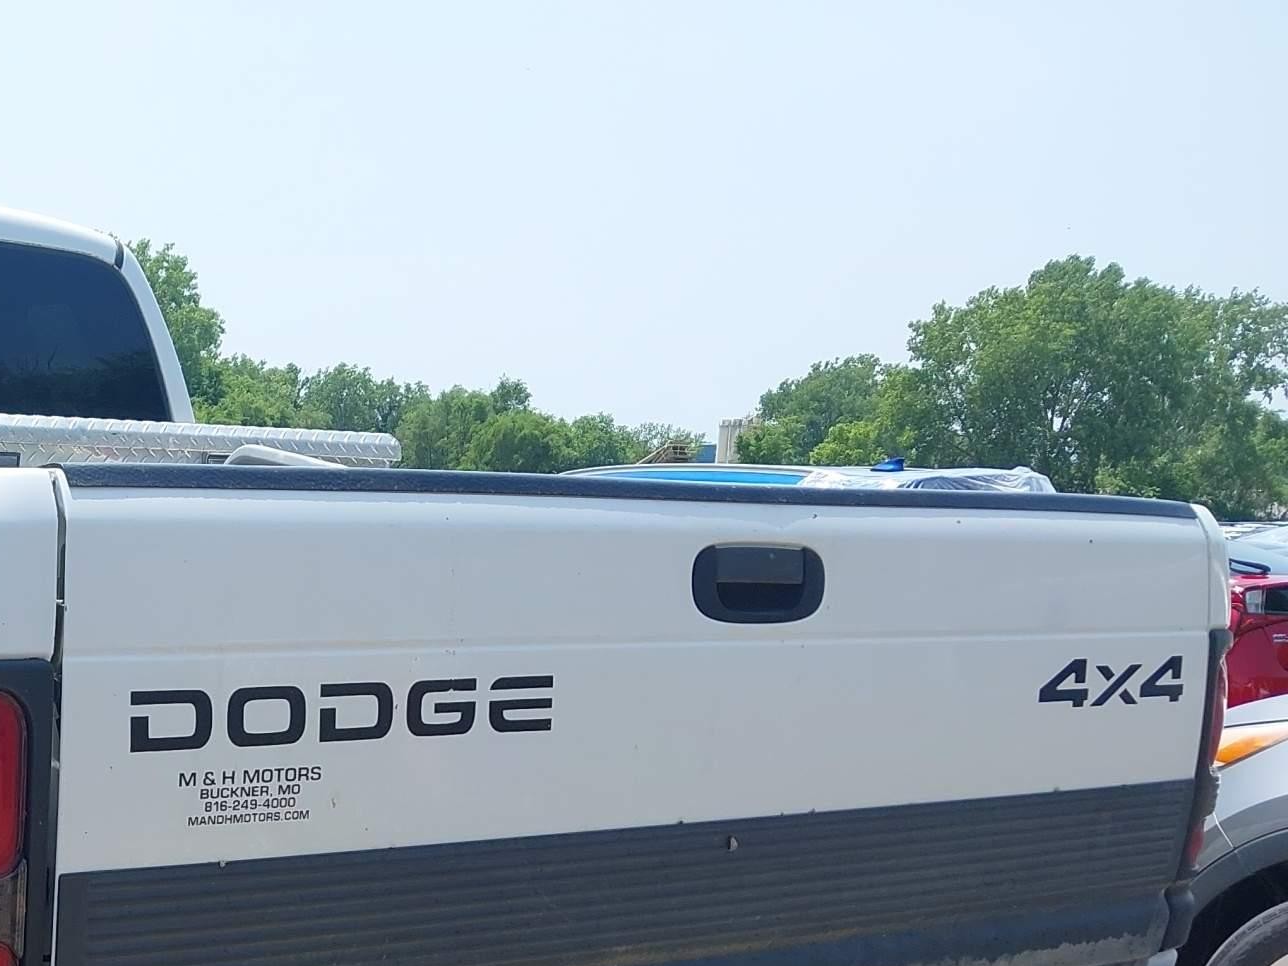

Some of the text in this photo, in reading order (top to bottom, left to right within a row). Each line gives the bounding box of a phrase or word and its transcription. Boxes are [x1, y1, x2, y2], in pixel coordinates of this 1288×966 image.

[130, 674, 554, 753] DODGE
[178, 766, 322, 787] M & H MOTORS
[199, 783, 301, 800] BUCKNER, MO
[204, 796, 296, 813] 816-249-4000
[187, 809, 310, 827] MANDHMOTORS.COM
